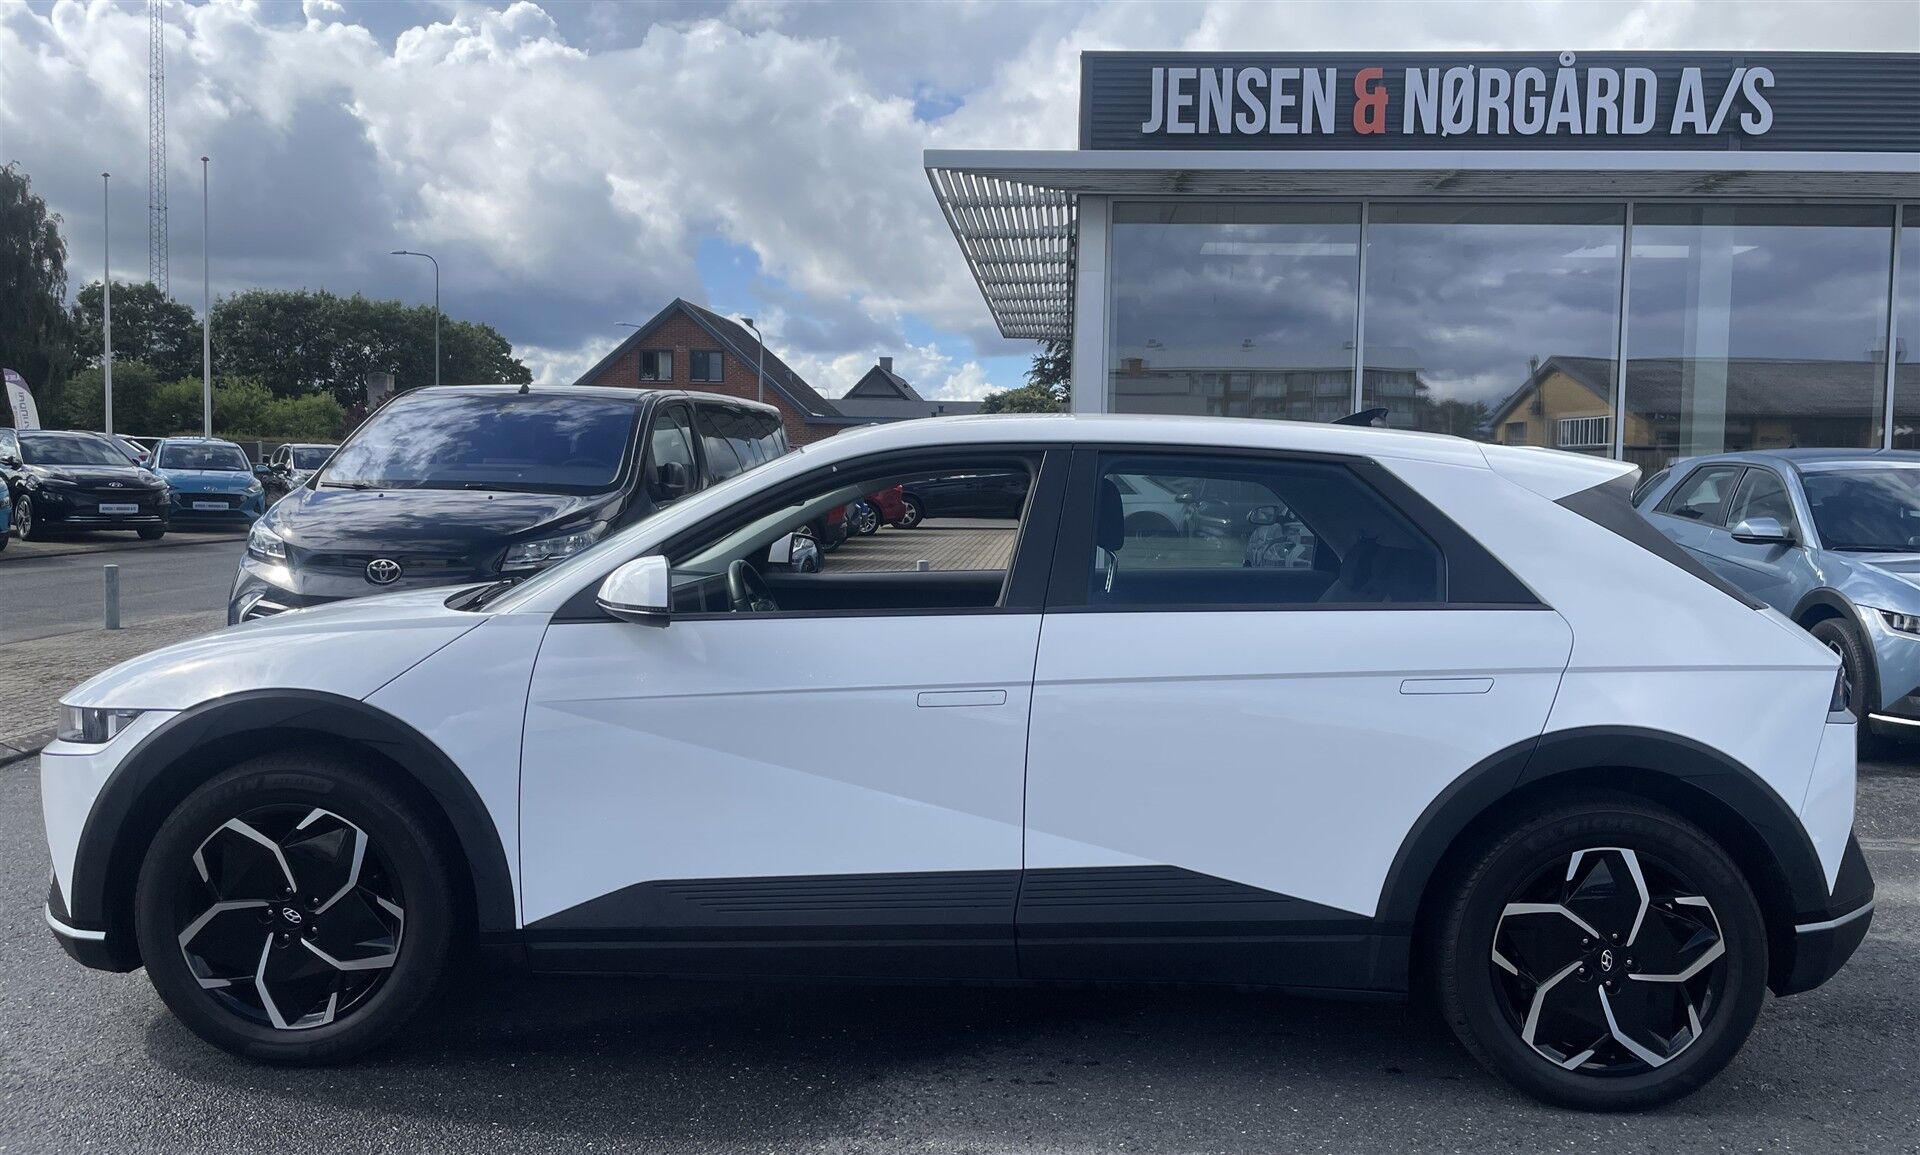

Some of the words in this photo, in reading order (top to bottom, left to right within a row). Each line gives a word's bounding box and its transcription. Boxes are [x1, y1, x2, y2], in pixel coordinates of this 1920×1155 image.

[1142, 67, 1337, 134] JENSEN
[1353, 67, 1389, 134] &
[1403, 50, 1658, 137] NØRGÅRD
[1670, 67, 1775, 135] A/S
